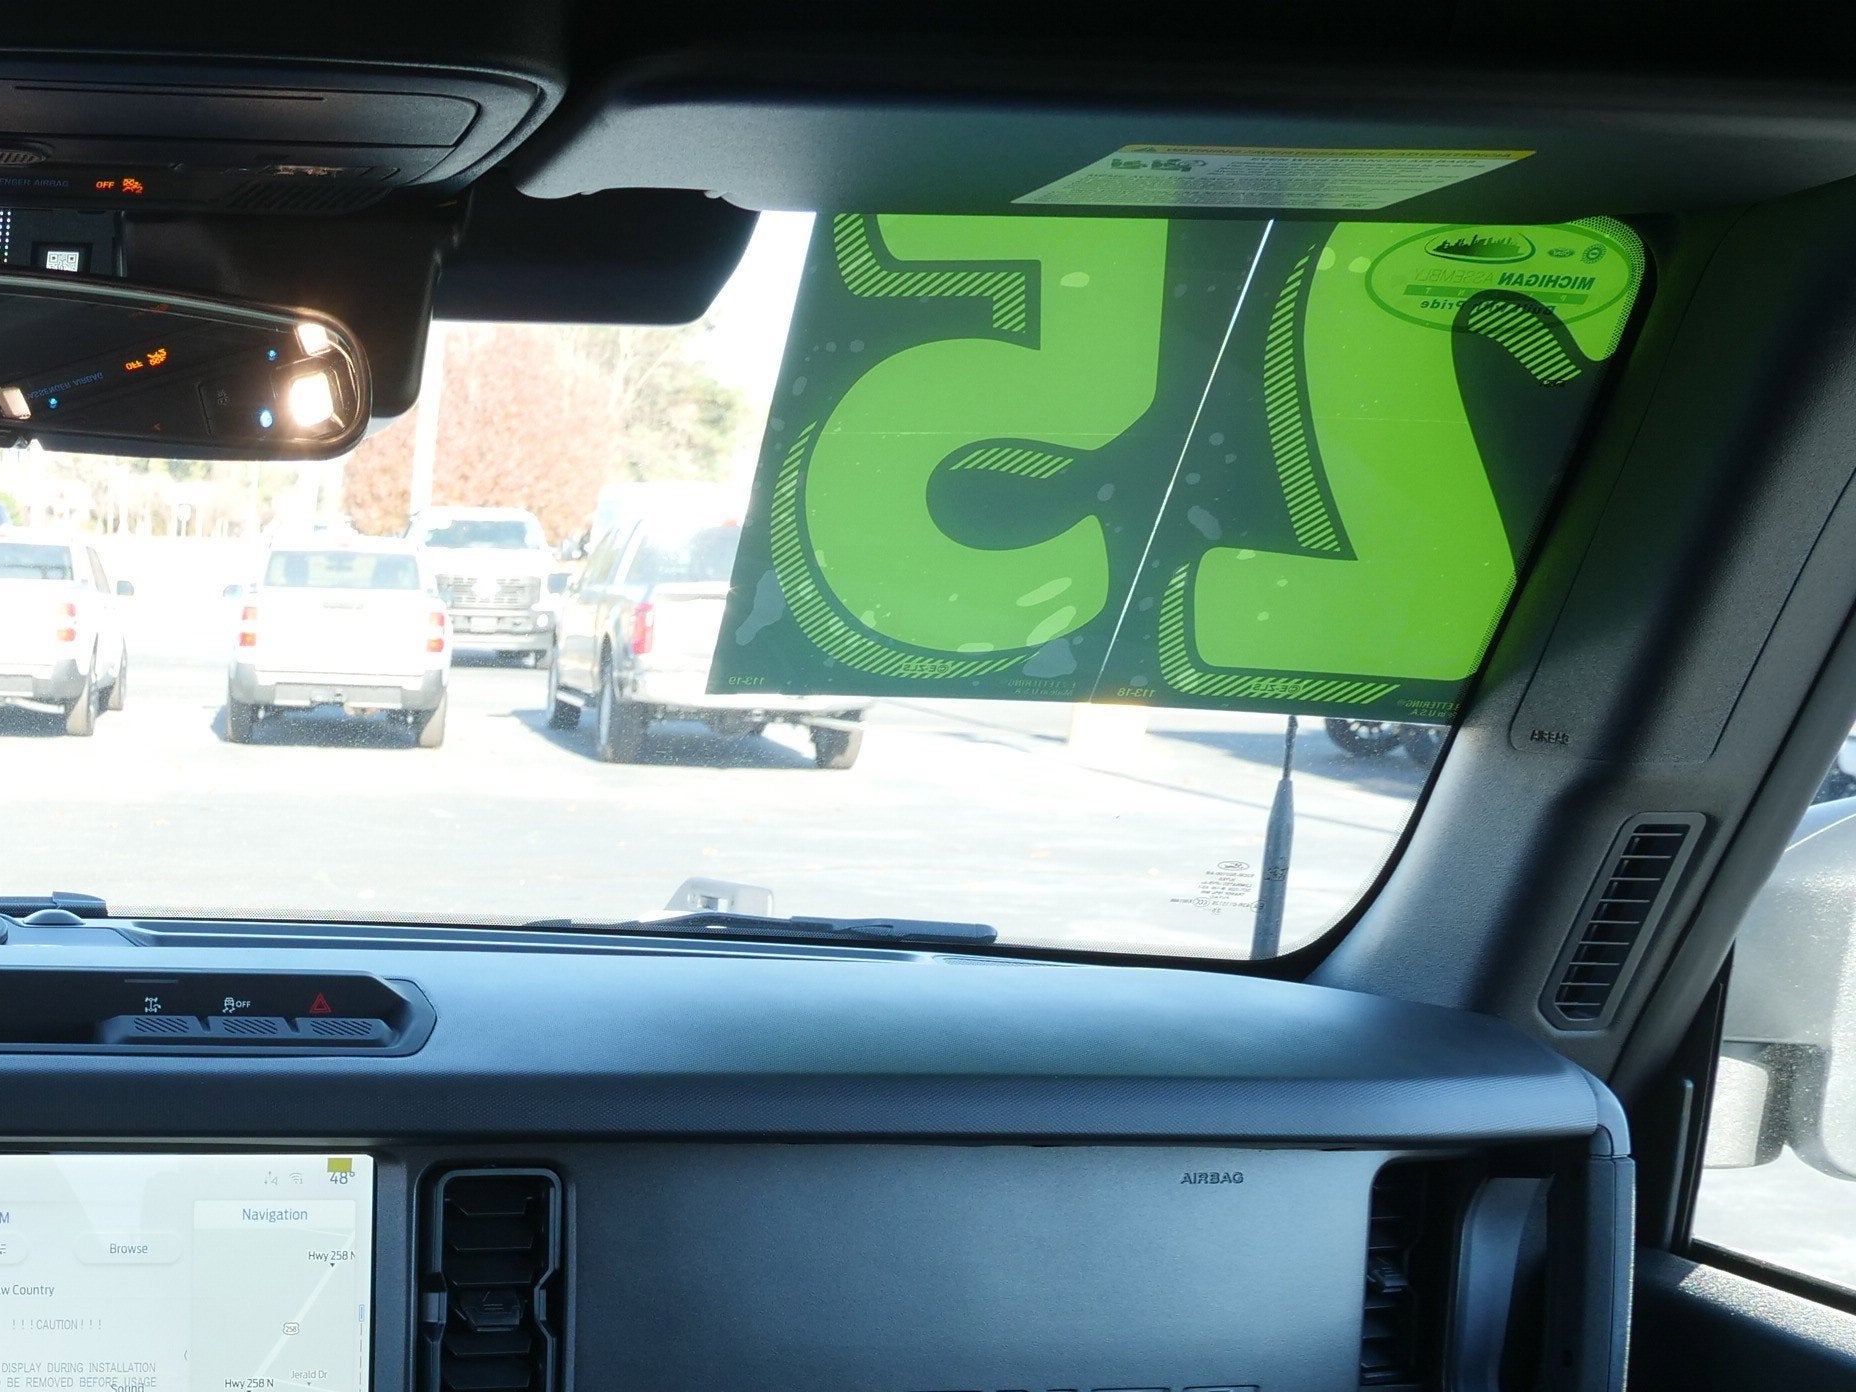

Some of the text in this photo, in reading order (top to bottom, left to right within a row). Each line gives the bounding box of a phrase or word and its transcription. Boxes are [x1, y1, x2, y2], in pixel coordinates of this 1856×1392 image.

[95, 180, 115, 190] OFF
[235, 1000, 251, 1009] OFF
[1180, 1171, 1245, 1186] AIRBAG
[241, 1208, 309, 1223] Navigation
[109, 1243, 149, 1255] Browse
[307, 1251, 329, 1262] Hwy
[330, 1250, 349, 1261] 258
[12, 1284, 55, 1297] Country
[1, 1362, 42, 1373] DISPLAY
[47, 1362, 84, 1373] DURING
[89, 1362, 157, 1373] INSTALLATION
[291, 1370, 328, 1380] Jerald Dr
[7, 1377, 20, 1388] BE
[26, 1377, 74, 1388] REMOVED
[79, 1377, 119, 1387] BEFORE
[124, 1377, 157, 1388] USAGE
[224, 1378, 275, 1390] Hwy 258 N
